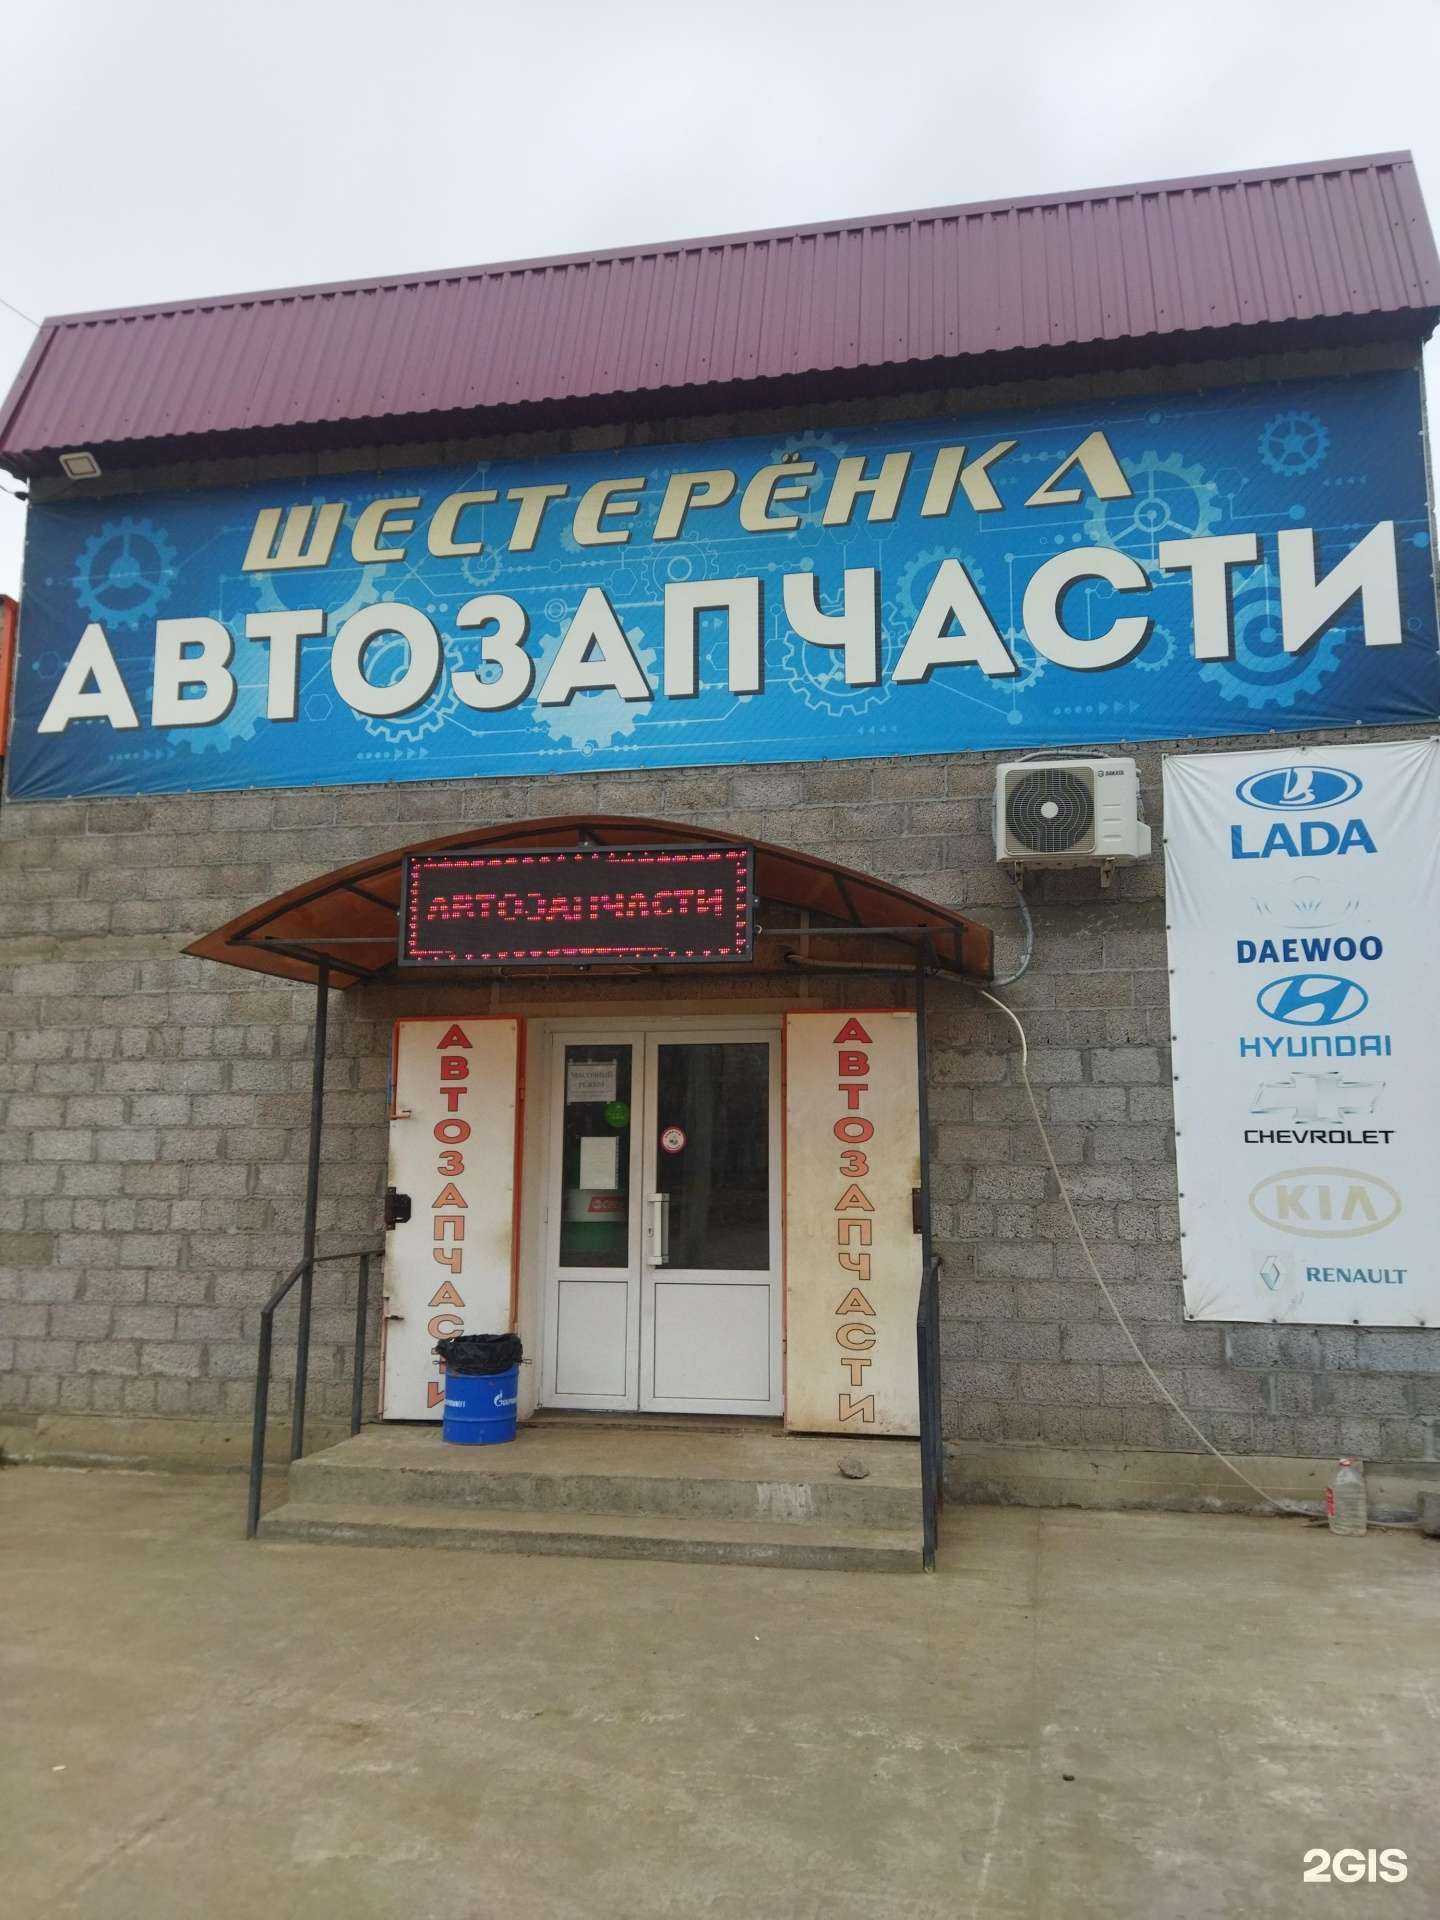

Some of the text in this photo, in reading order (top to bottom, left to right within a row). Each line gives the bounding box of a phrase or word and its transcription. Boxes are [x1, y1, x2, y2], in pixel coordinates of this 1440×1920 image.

[242, 431, 1133, 573] ШЕСТЕРЁНКА
[37, 520, 1402, 734] АВТОЗАПЧАСТИ
[1230, 818, 1378, 860] LADA
[1236, 935, 1384, 964] DAEWOO
[1239, 1035, 1392, 1058] HYUNDAI
[1243, 1130, 1396, 1145] CHEVROLET
[427, 1023, 473, 1409] АВТОЗАПЧАС
[832, 1017, 876, 1424] АВТОЗАПЧАСТИ
[1275, 1184, 1379, 1222] KIA
[1306, 1266, 1408, 1285] RENAULT
